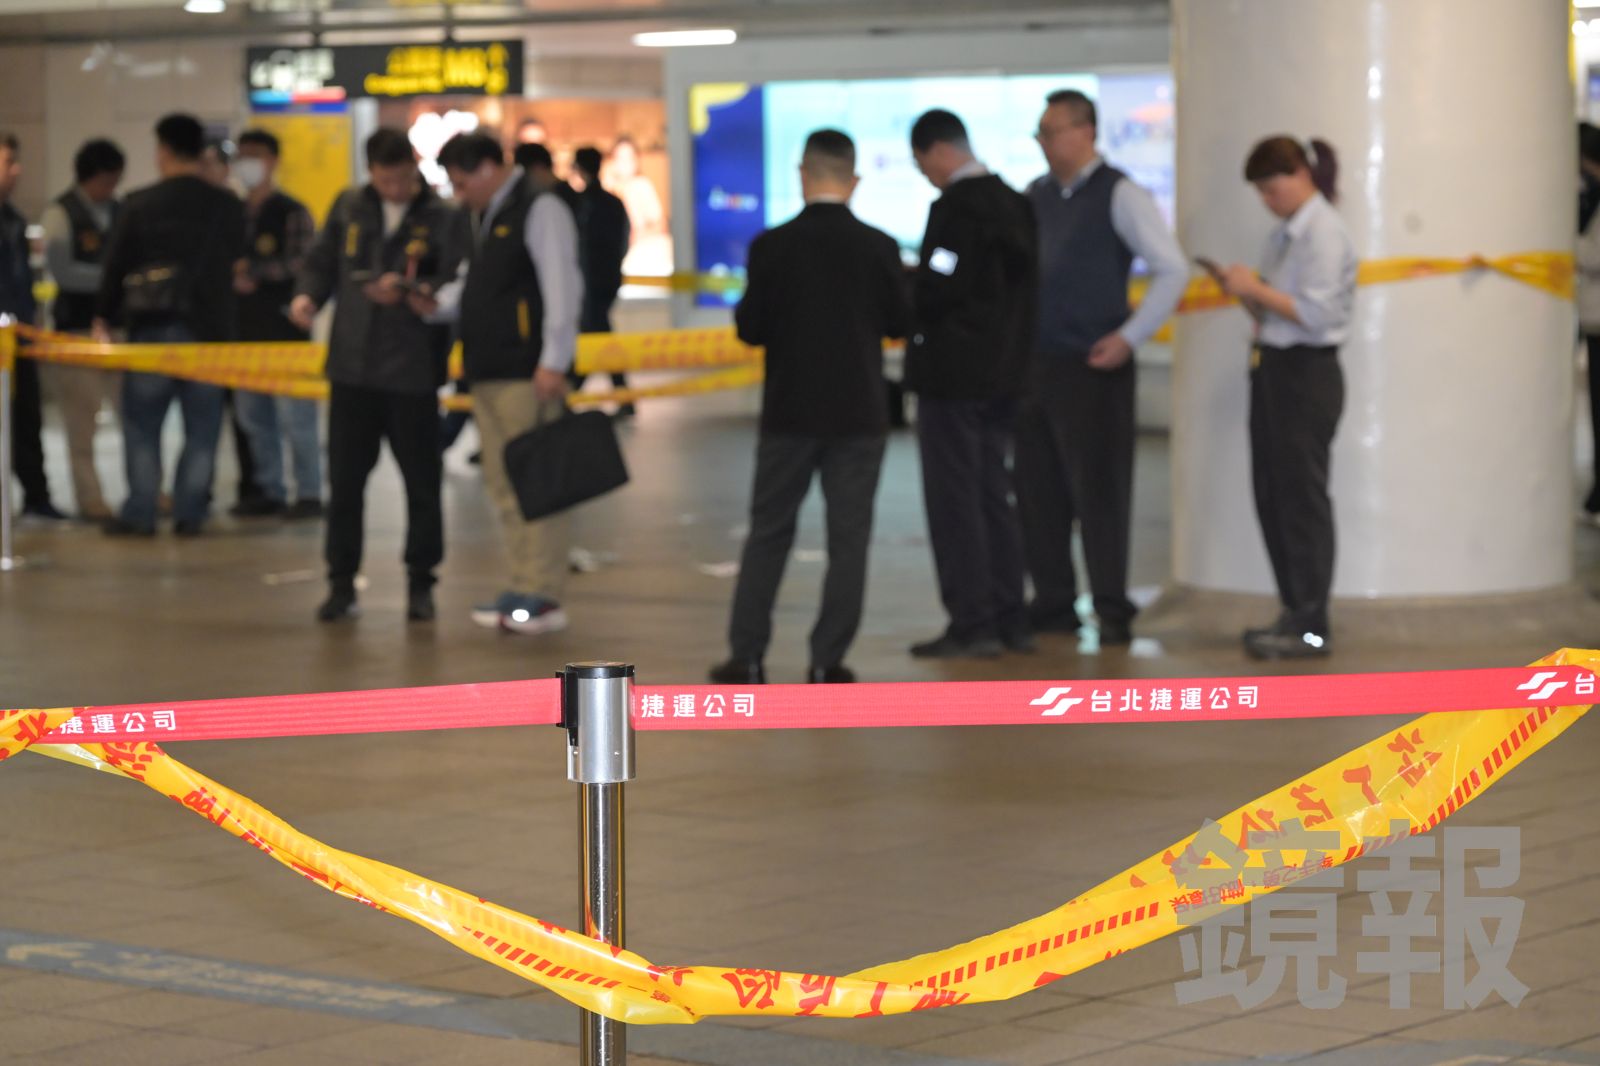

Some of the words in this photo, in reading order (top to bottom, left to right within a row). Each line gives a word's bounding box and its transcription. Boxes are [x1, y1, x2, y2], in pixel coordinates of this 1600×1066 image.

[1575, 673, 1595, 695] 台
[632, 693, 755, 718] 捷運公司
[1090, 685, 1258, 712] 台北捷運公司
[48, 709, 177, 735] 捷運公司
